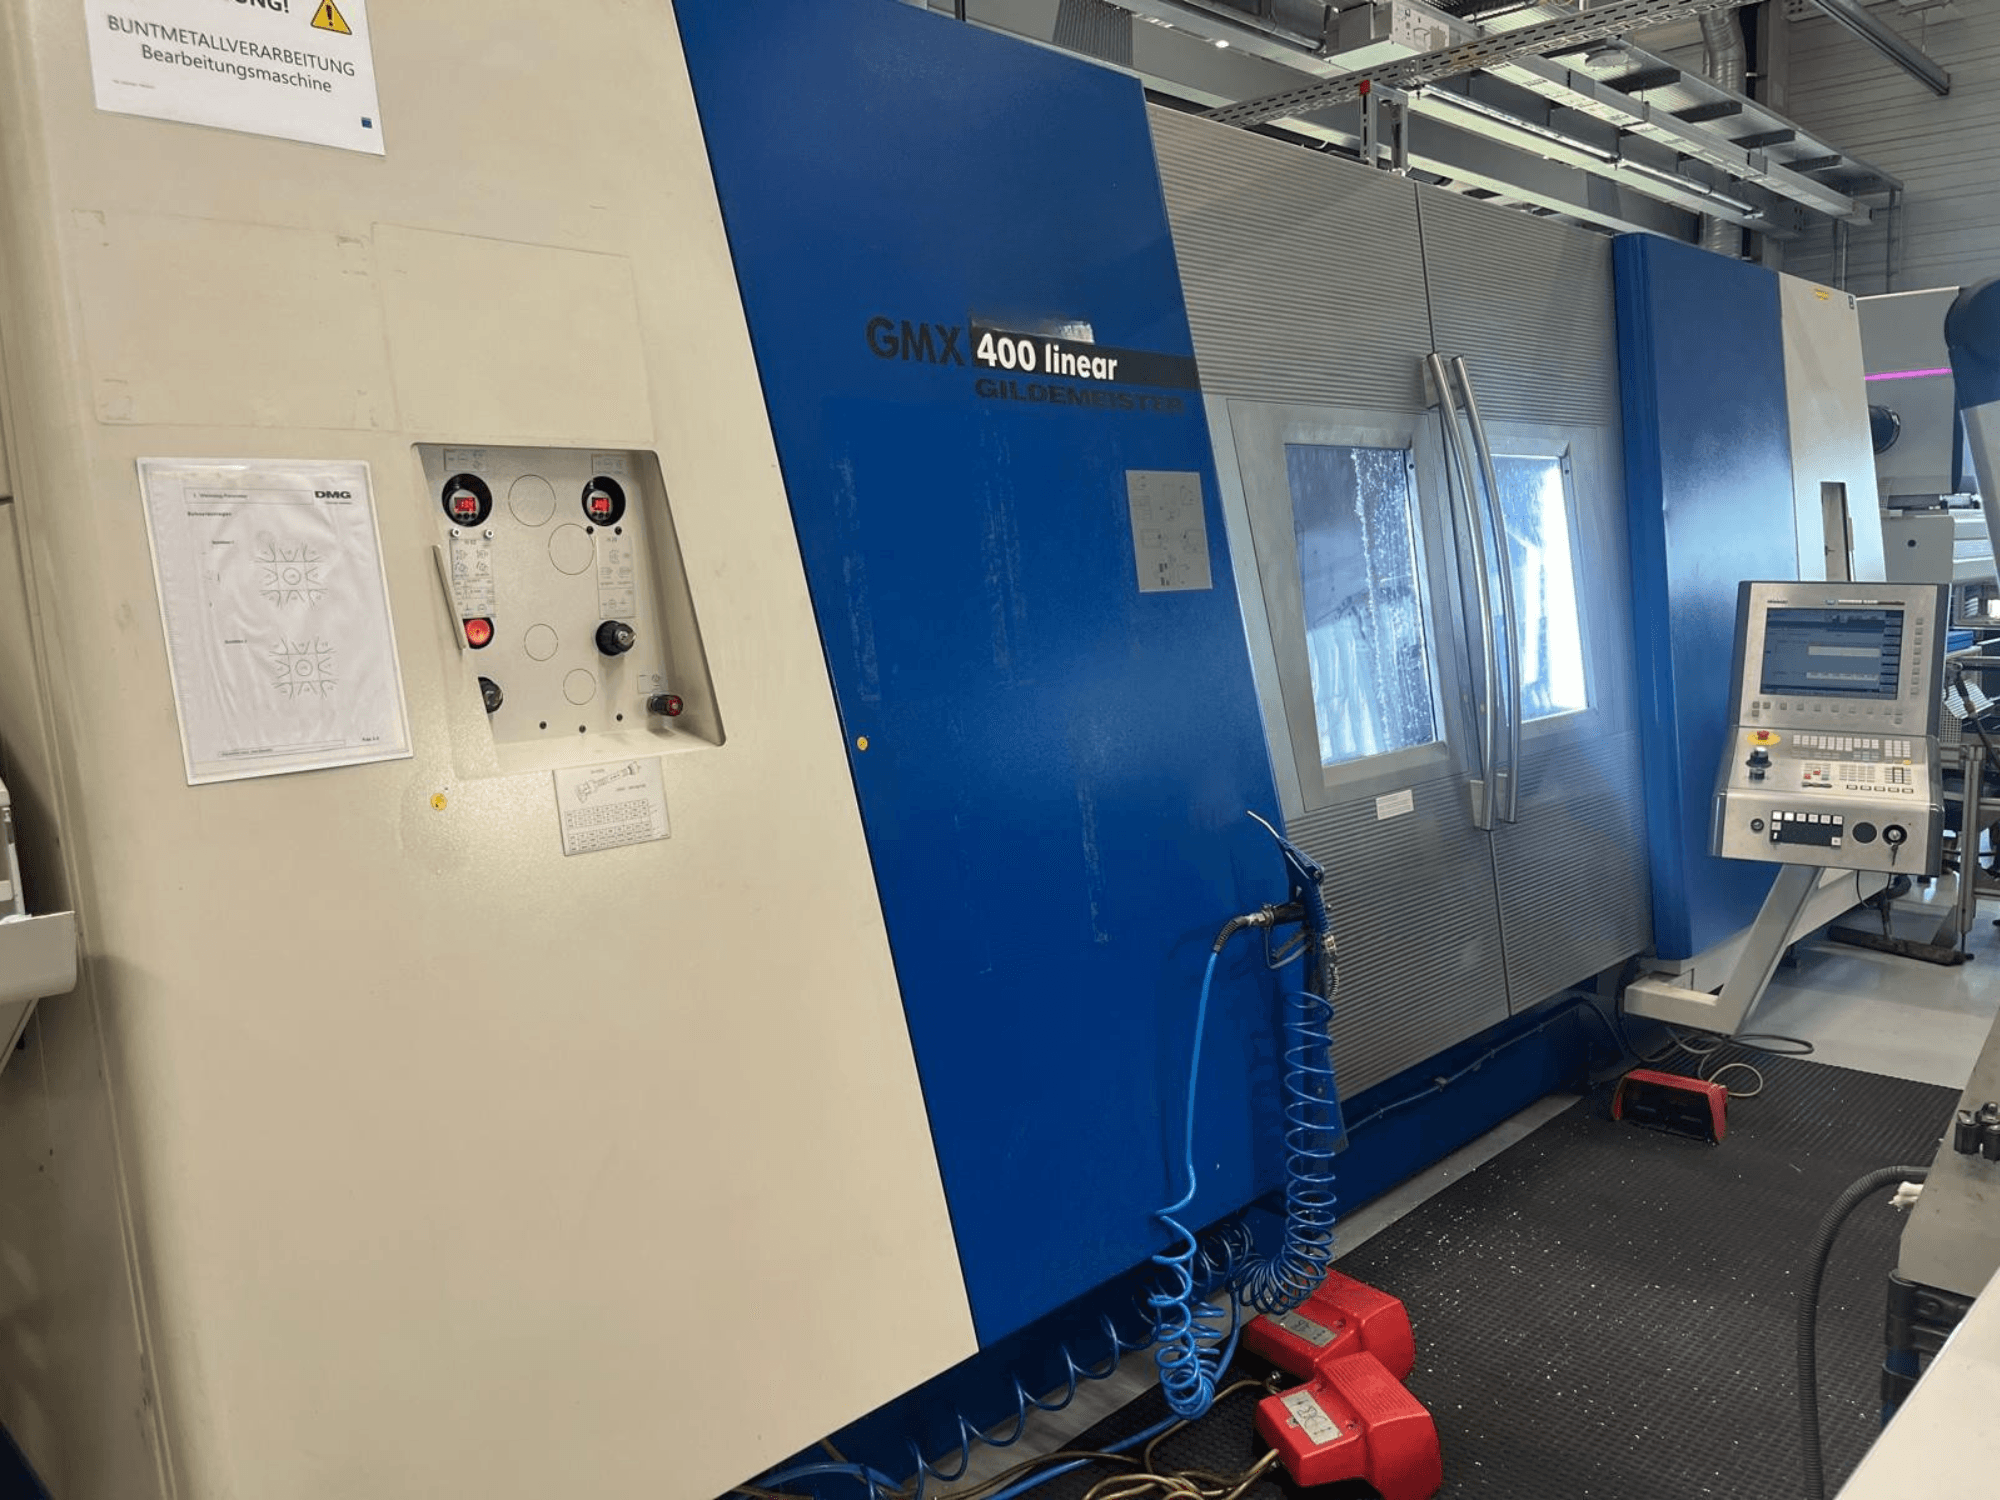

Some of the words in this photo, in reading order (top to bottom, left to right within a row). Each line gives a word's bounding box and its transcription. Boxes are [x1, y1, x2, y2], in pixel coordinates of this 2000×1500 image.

[107, 14, 356, 77] BUNTMETALLVERARBEITUNG
[141, 44, 332, 93] Bearbeitungsmaschine
[865, 315, 965, 367] GMX
[976, 332, 1036, 372] 400
[1045, 343, 1118, 381] linear
[974, 377, 1184, 413] GILDEMEISTER
[314, 490, 352, 499] DMG
